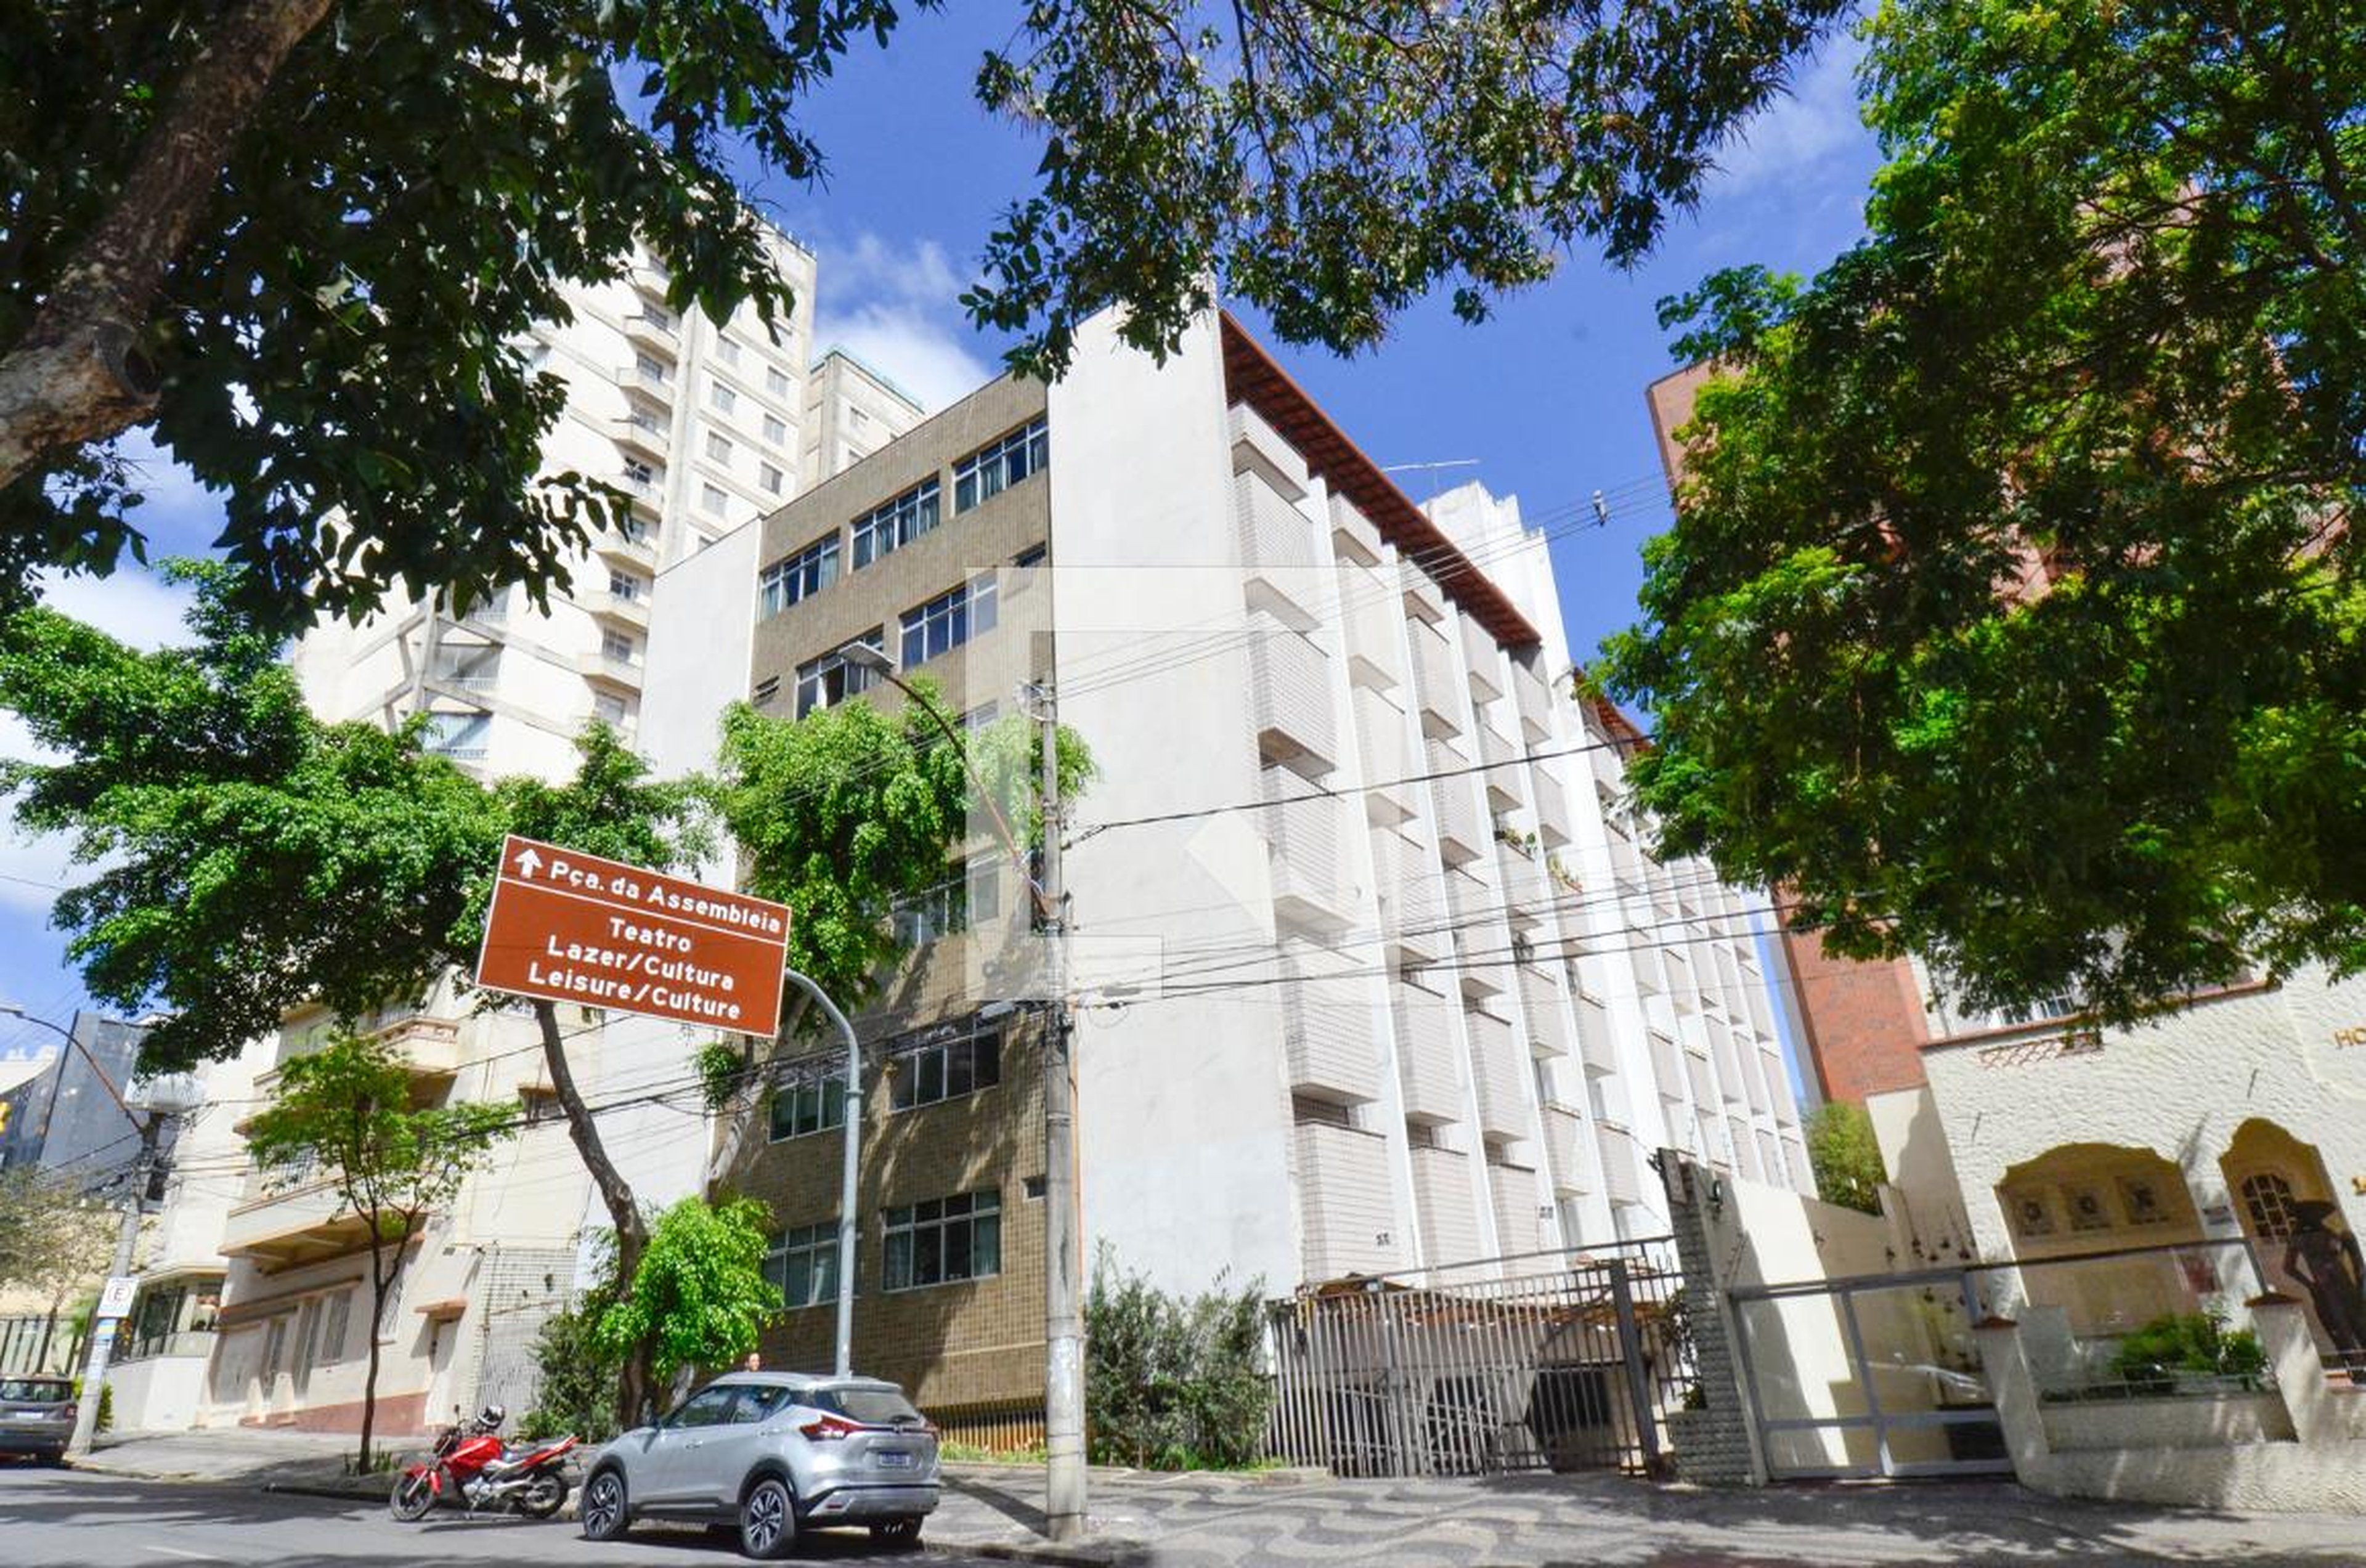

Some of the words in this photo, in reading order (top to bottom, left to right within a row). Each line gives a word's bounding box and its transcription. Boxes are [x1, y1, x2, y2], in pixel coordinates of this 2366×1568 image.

[550, 860, 604, 891] Pça.
[611, 877, 640, 900] da
[647, 885, 781, 933] Assembleia
[547, 935, 734, 991] Lazer/Cultura
[609, 917, 691, 953] Teatro
[528, 962, 741, 1020] Leisure/Culture
